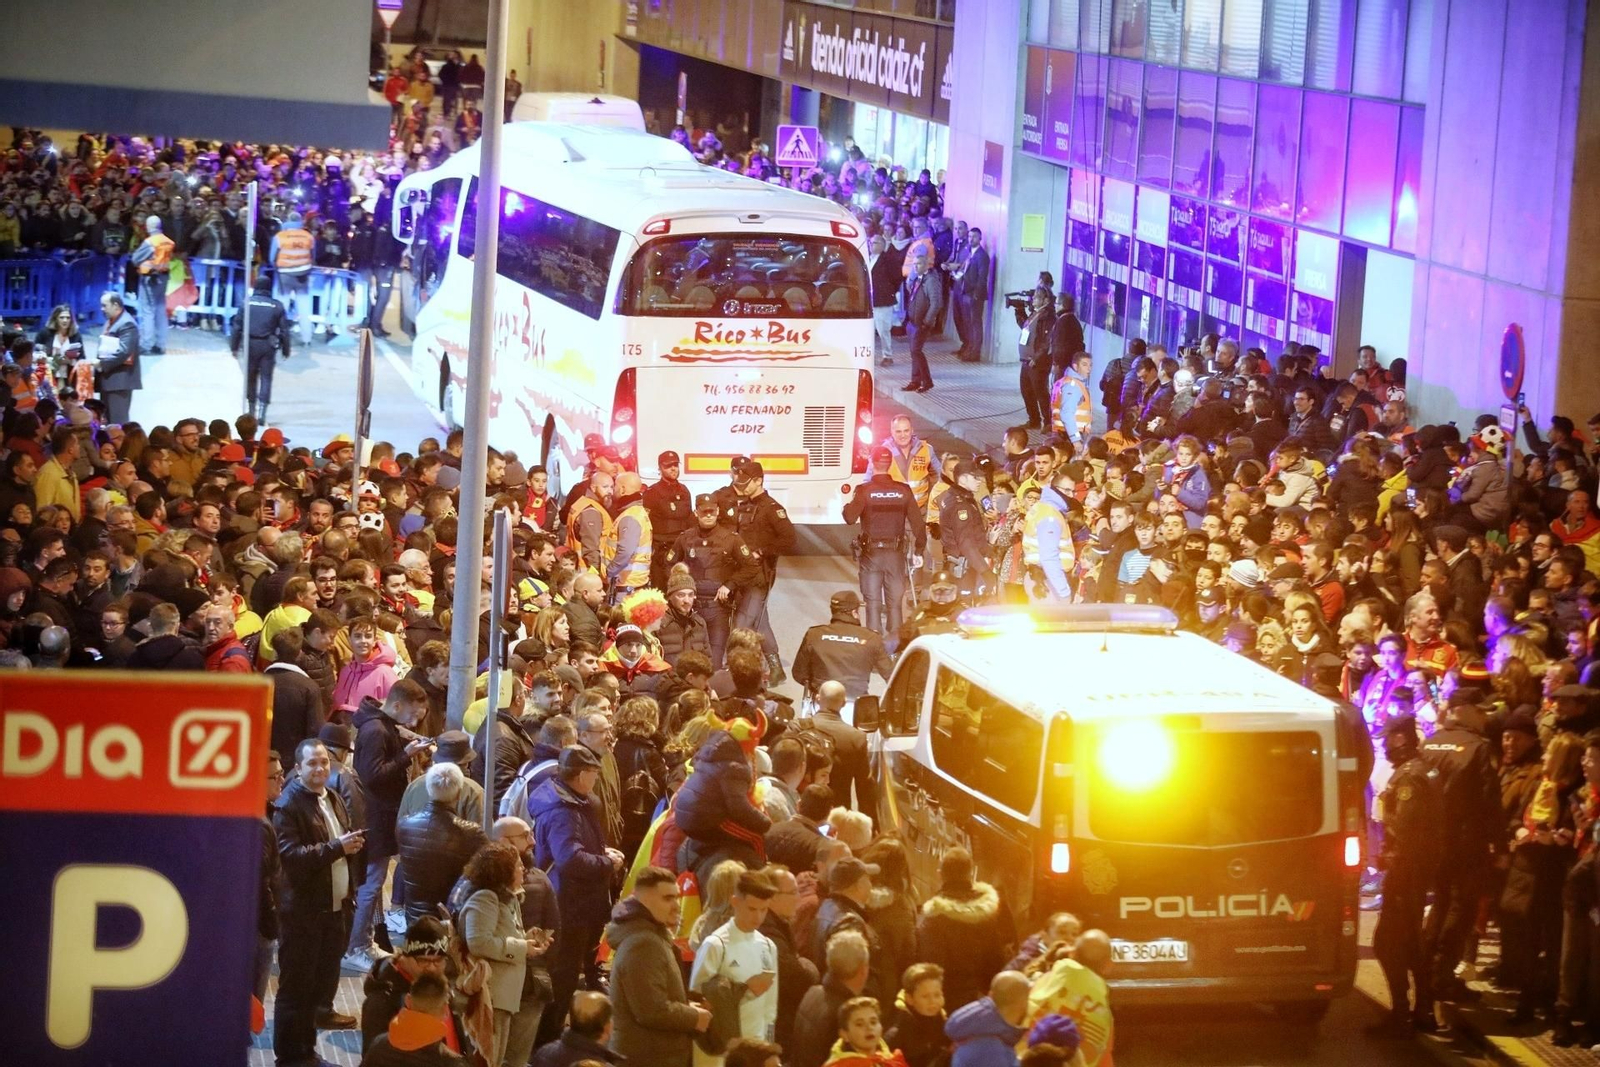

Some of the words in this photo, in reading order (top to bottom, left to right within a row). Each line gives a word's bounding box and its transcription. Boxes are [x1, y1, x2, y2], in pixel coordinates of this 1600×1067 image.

[811, 21, 845, 77] tienda
[845, 27, 879, 85] oficial
[910, 41, 926, 97] cf
[767, 321, 811, 344] Bus
[622, 344, 642, 356] 175
[854, 346, 871, 358] 175
[725, 384, 745, 394] 956
[748, 384, 762, 394] 88
[765, 384, 779, 394] 36
[782, 384, 795, 394] 92
[705, 405, 728, 415] SAN
[731, 405, 792, 415] FERNANDO
[730, 424, 765, 434] CADIZ
[1119, 889, 1294, 919] POLICÍA
[45, 863, 189, 1049] P
[1112, 944, 1186, 961] NP3604AU
